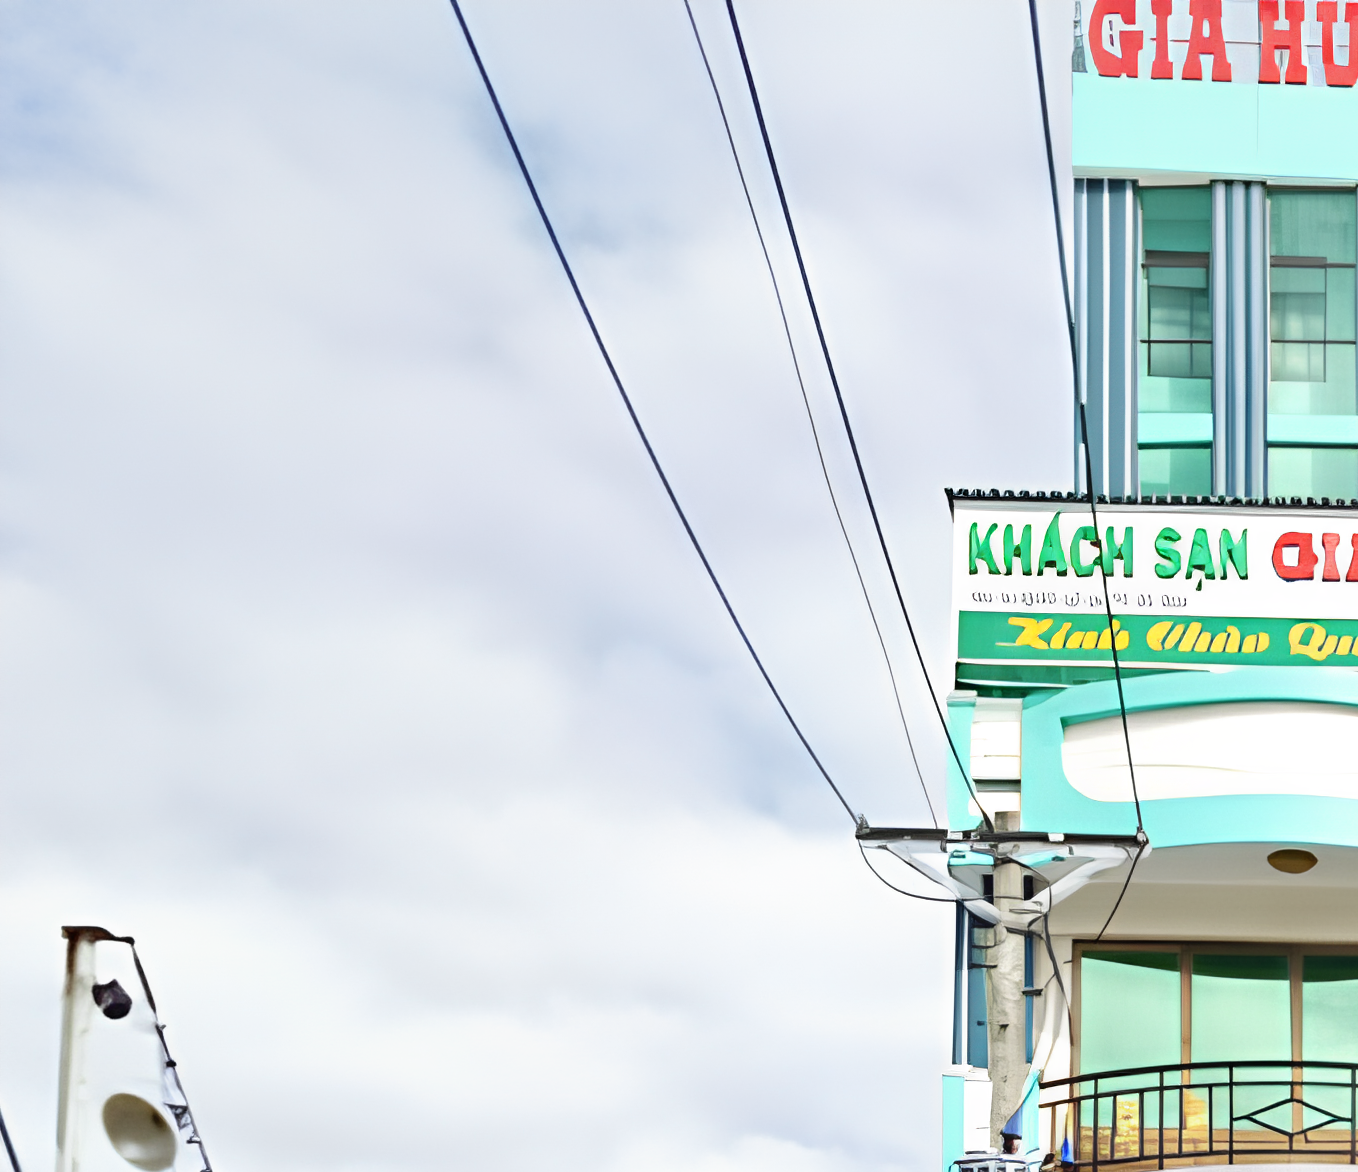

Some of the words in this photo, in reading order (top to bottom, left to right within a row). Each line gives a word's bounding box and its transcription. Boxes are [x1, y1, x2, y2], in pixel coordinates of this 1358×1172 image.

[1089, 0, 1232, 81] GIA
[969, 509, 1133, 579] KHÁCH
[1154, 526, 1248, 592] SẠN
